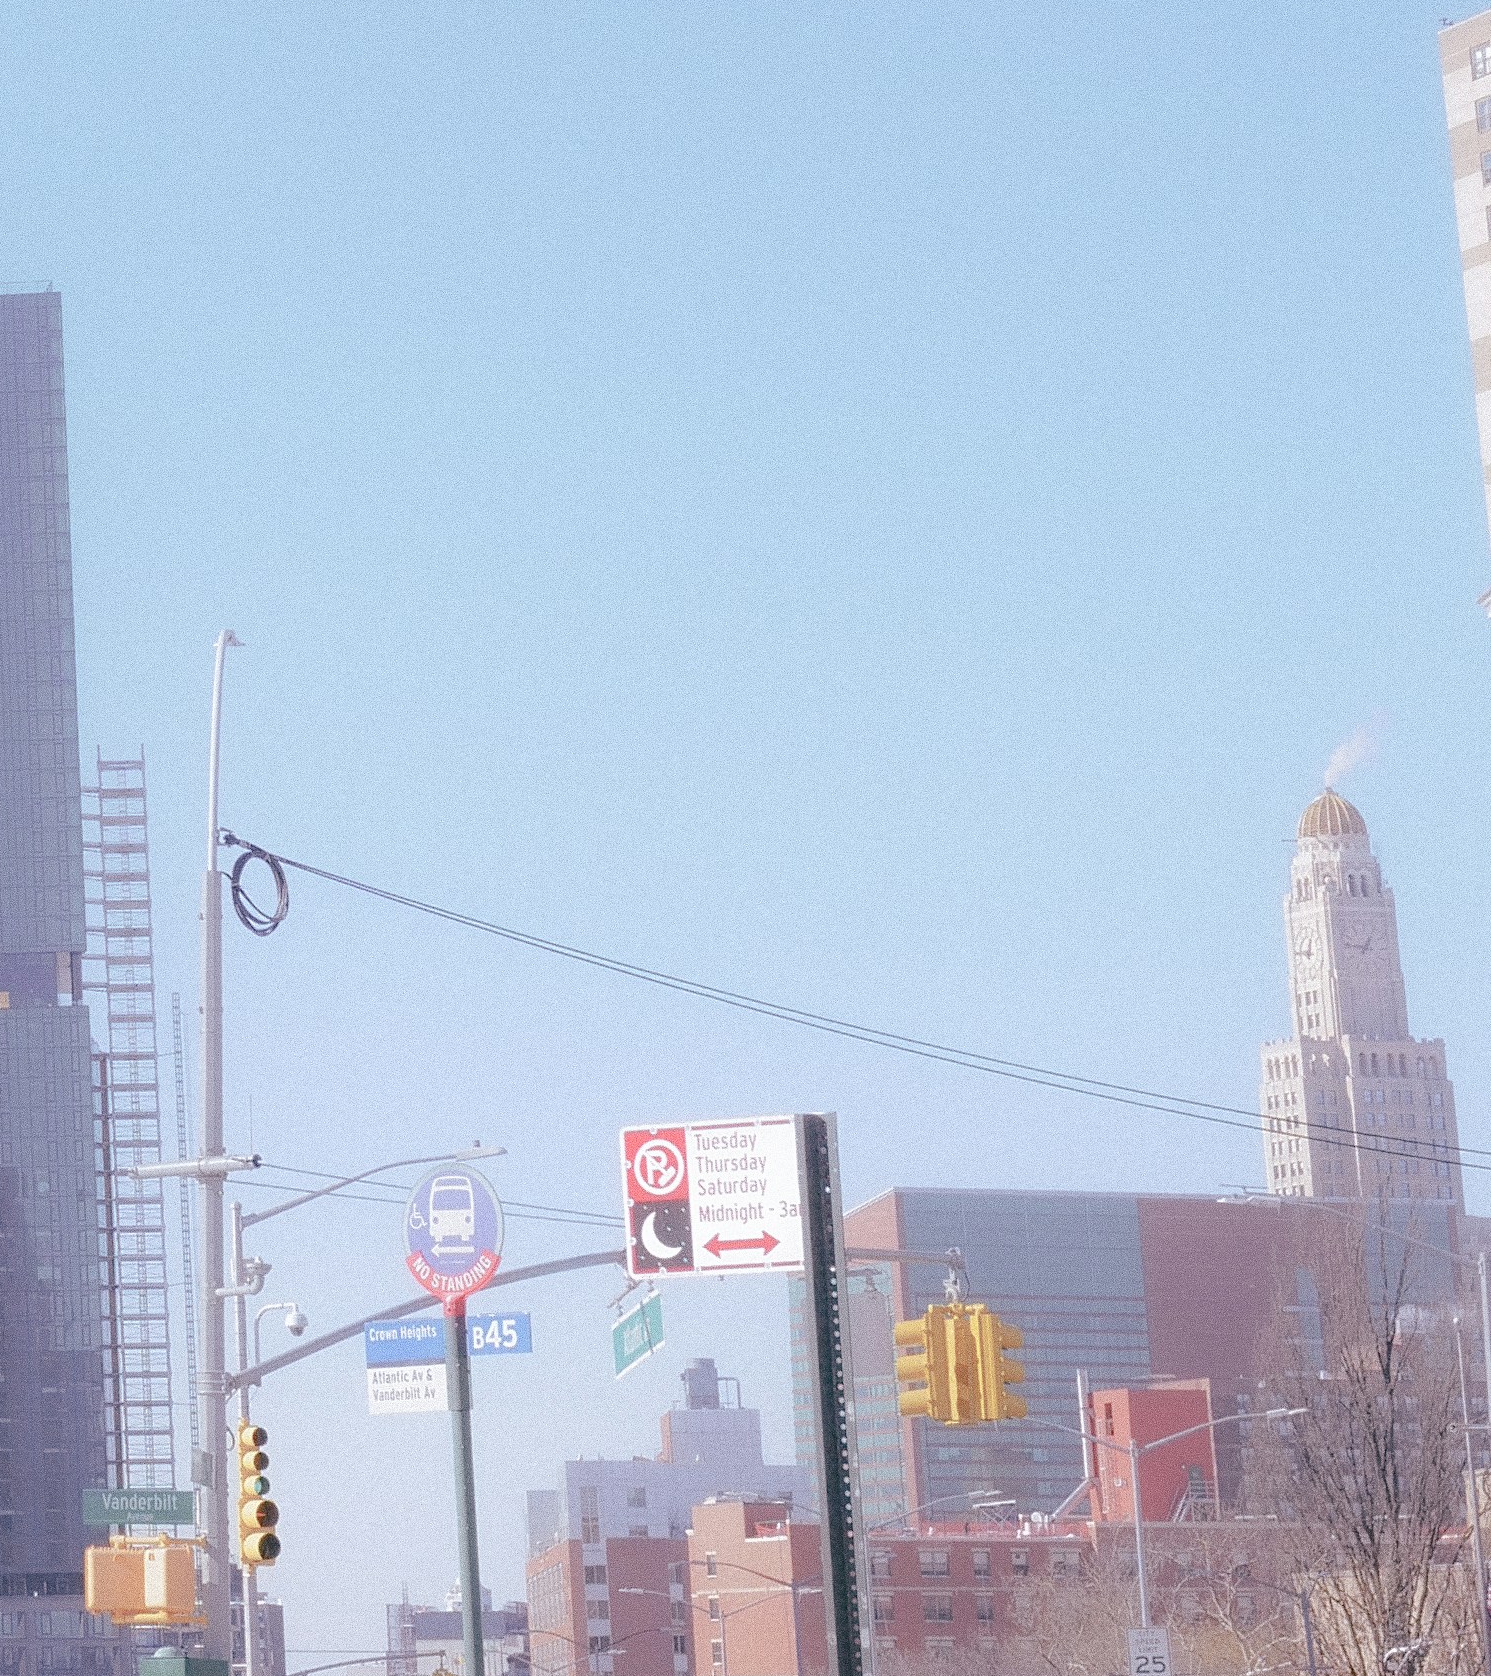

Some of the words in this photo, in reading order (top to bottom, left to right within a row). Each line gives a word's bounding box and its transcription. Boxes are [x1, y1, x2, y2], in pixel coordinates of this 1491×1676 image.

[694, 1131, 757, 1151] Tuesday
[695, 1154, 767, 1174] Thursday
[697, 1176, 767, 1197] Saturday
[698, 1202, 764, 1225] Midnight
[412, 1256, 431, 1280] NO
[430, 1254, 492, 1292] STANDING
[369, 1327, 398, 1342] Crown
[400, 1325, 438, 1342] Heights
[472, 1319, 518, 1349] B45
[372, 1371, 410, 1384] Atlantic
[412, 1369, 424, 1382] Av
[372, 1387, 421, 1402] Vanderbilt
[425, 1386, 437, 1399] Av
[101, 1493, 177, 1510] Vanderbilt
[1135, 1655, 1167, 1674] 25
